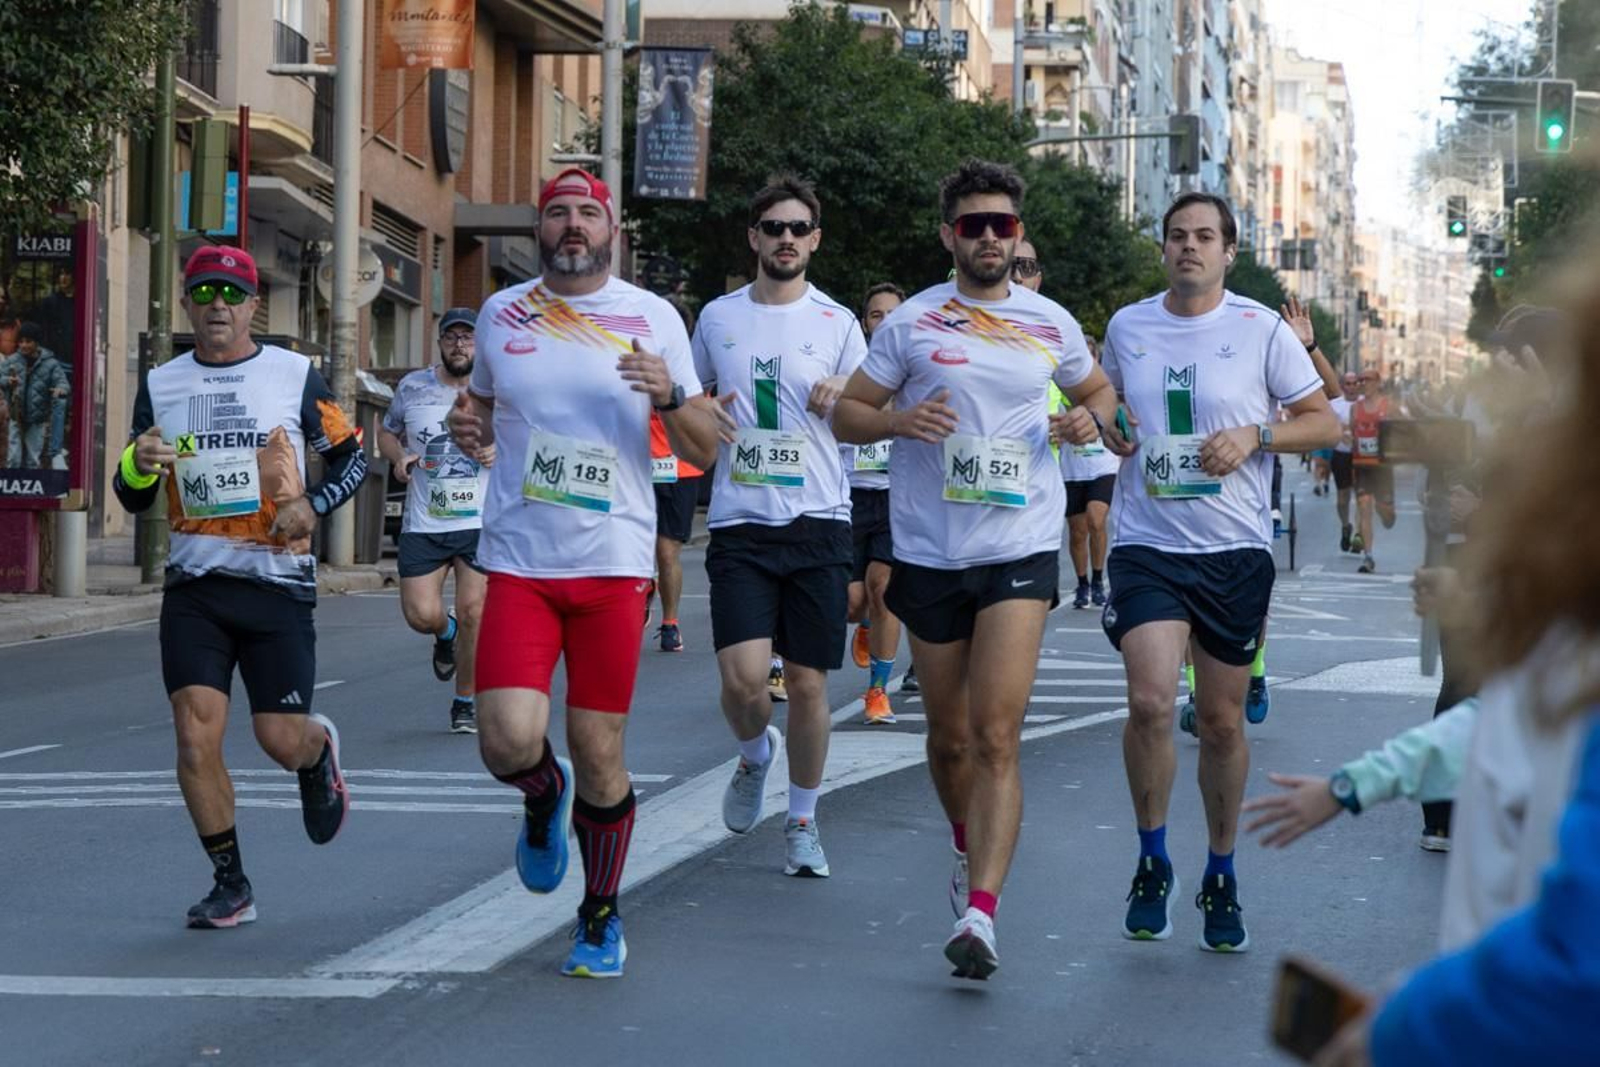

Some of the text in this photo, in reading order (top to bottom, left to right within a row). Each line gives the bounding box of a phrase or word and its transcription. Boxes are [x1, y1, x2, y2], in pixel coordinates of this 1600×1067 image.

[18, 237, 72, 251] KIABI
[178, 432, 269, 453] XTREME
[768, 448, 800, 463] 353
[573, 463, 610, 483] 183
[989, 460, 1019, 477] 521
[215, 471, 250, 488] 343
[452, 491, 474, 501] 549
